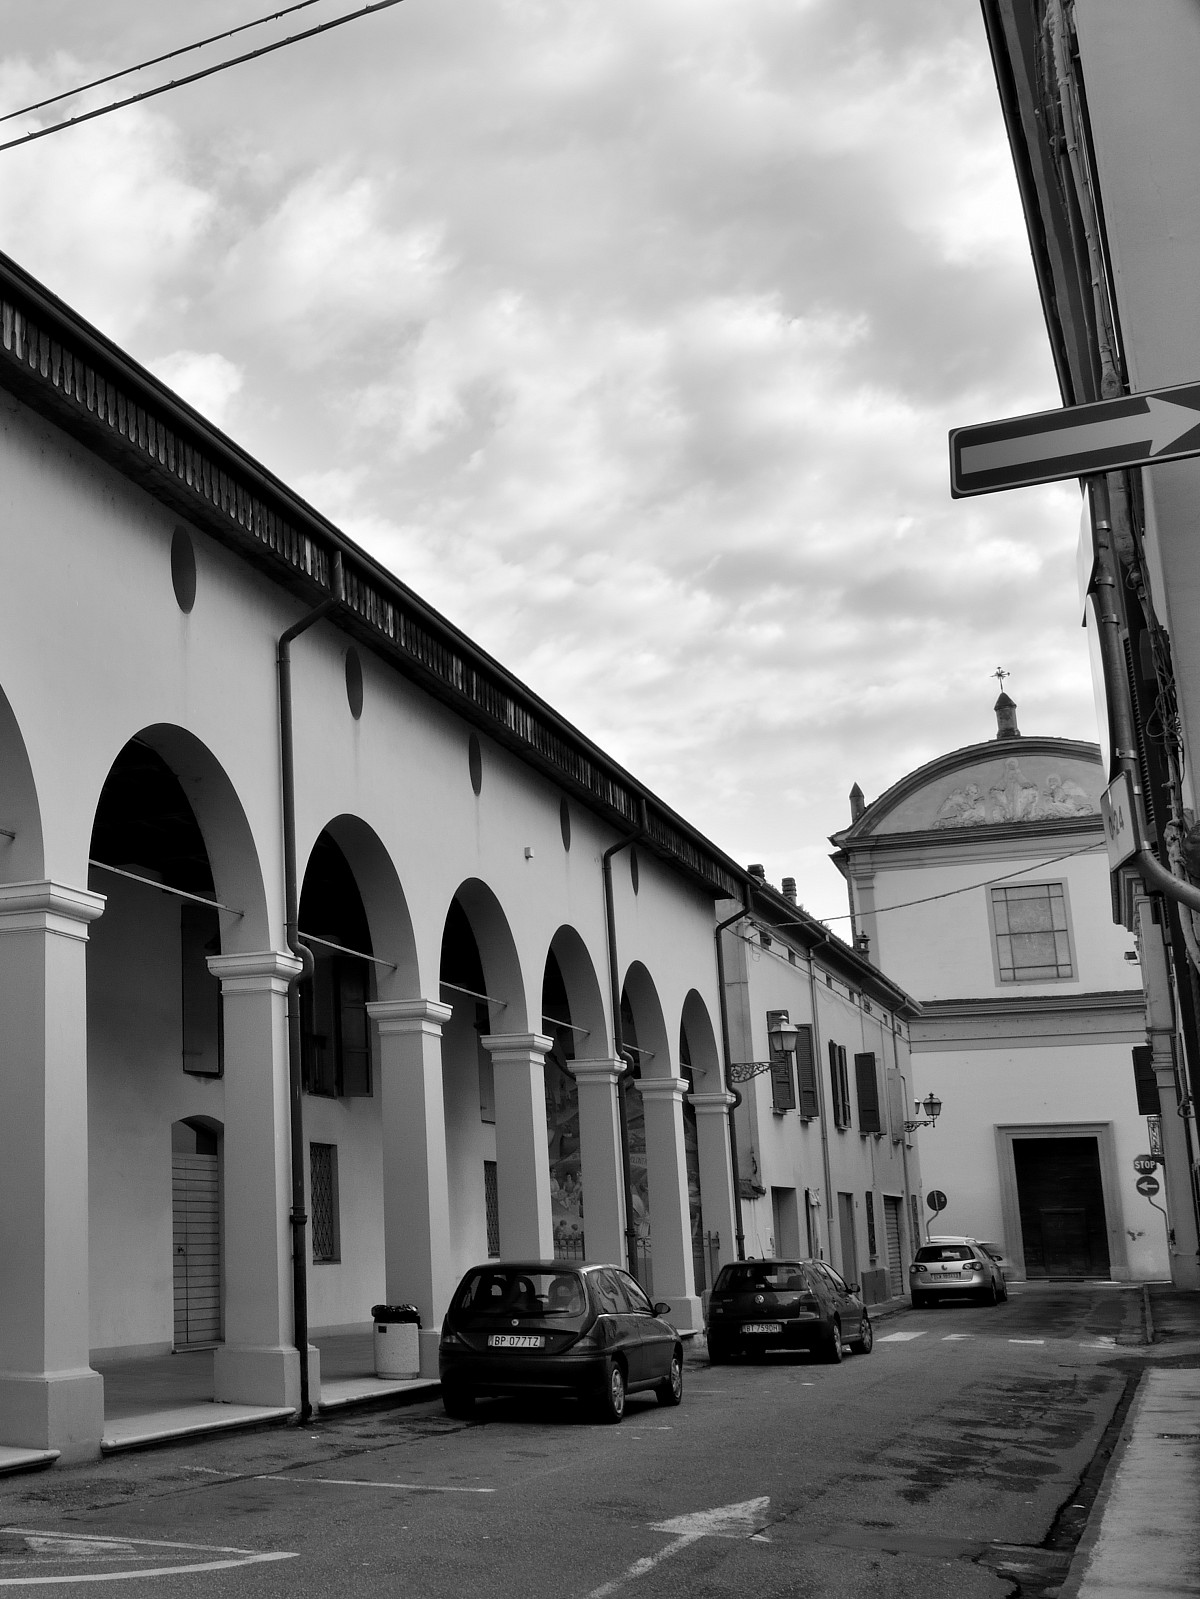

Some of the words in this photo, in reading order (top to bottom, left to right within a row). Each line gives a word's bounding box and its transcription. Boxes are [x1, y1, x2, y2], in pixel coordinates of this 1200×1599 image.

[1134, 1160, 1156, 1169] STOP
[494, 1336, 506, 1346] BP
[509, 1336, 539, 1347] 077TZ
